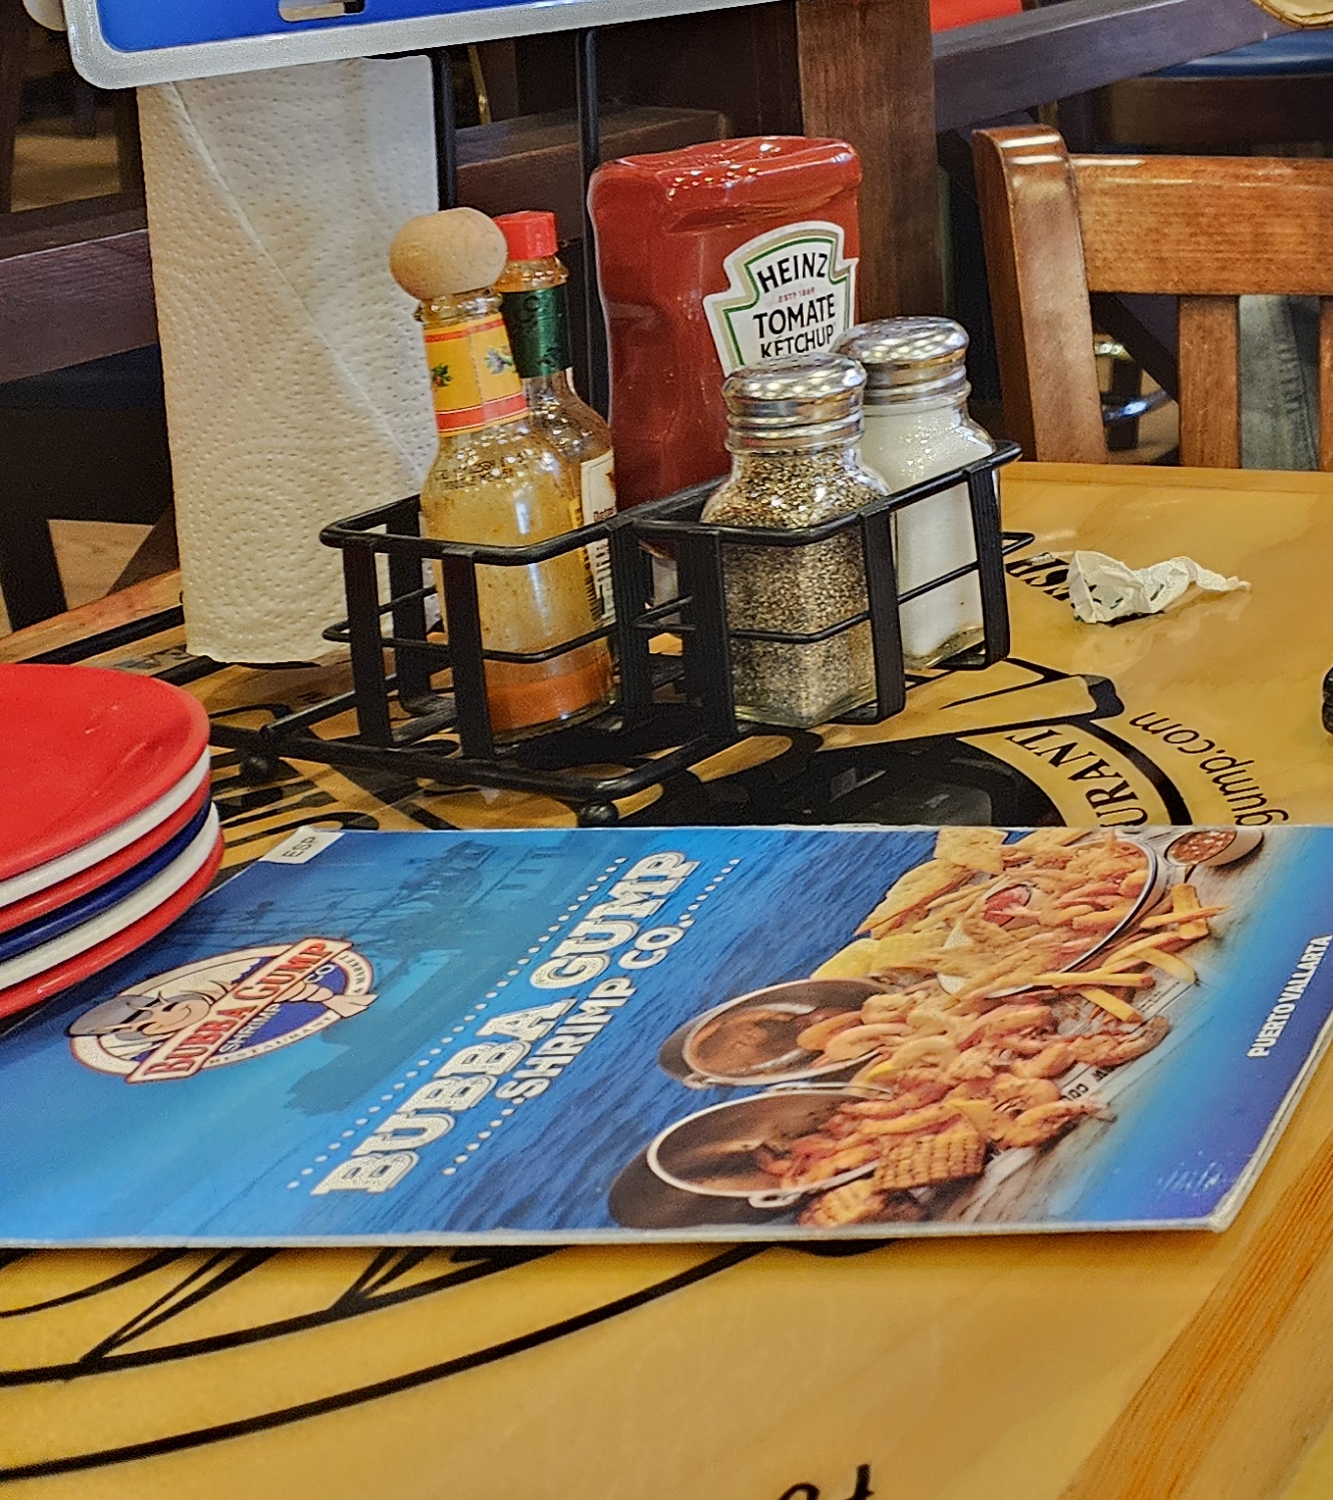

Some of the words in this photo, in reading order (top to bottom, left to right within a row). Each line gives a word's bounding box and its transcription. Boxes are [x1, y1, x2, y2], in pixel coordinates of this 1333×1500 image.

[753, 293, 836, 339] TOMATE
[757, 252, 828, 294] HEINZ
[283, 836, 316, 858] ESP
[142, 1004, 259, 1077] BUBBA
[233, 942, 334, 1000] GUMP
[219, 1003, 282, 1054] SHRIMP
[309, 998, 578, 1196] BUBBA
[530, 851, 701, 990] GUMP
[494, 976, 638, 1101] SHRIMP
[1246, 997, 1298, 1059] PUERTO
[1278, 933, 1333, 1013] VALLARTA
